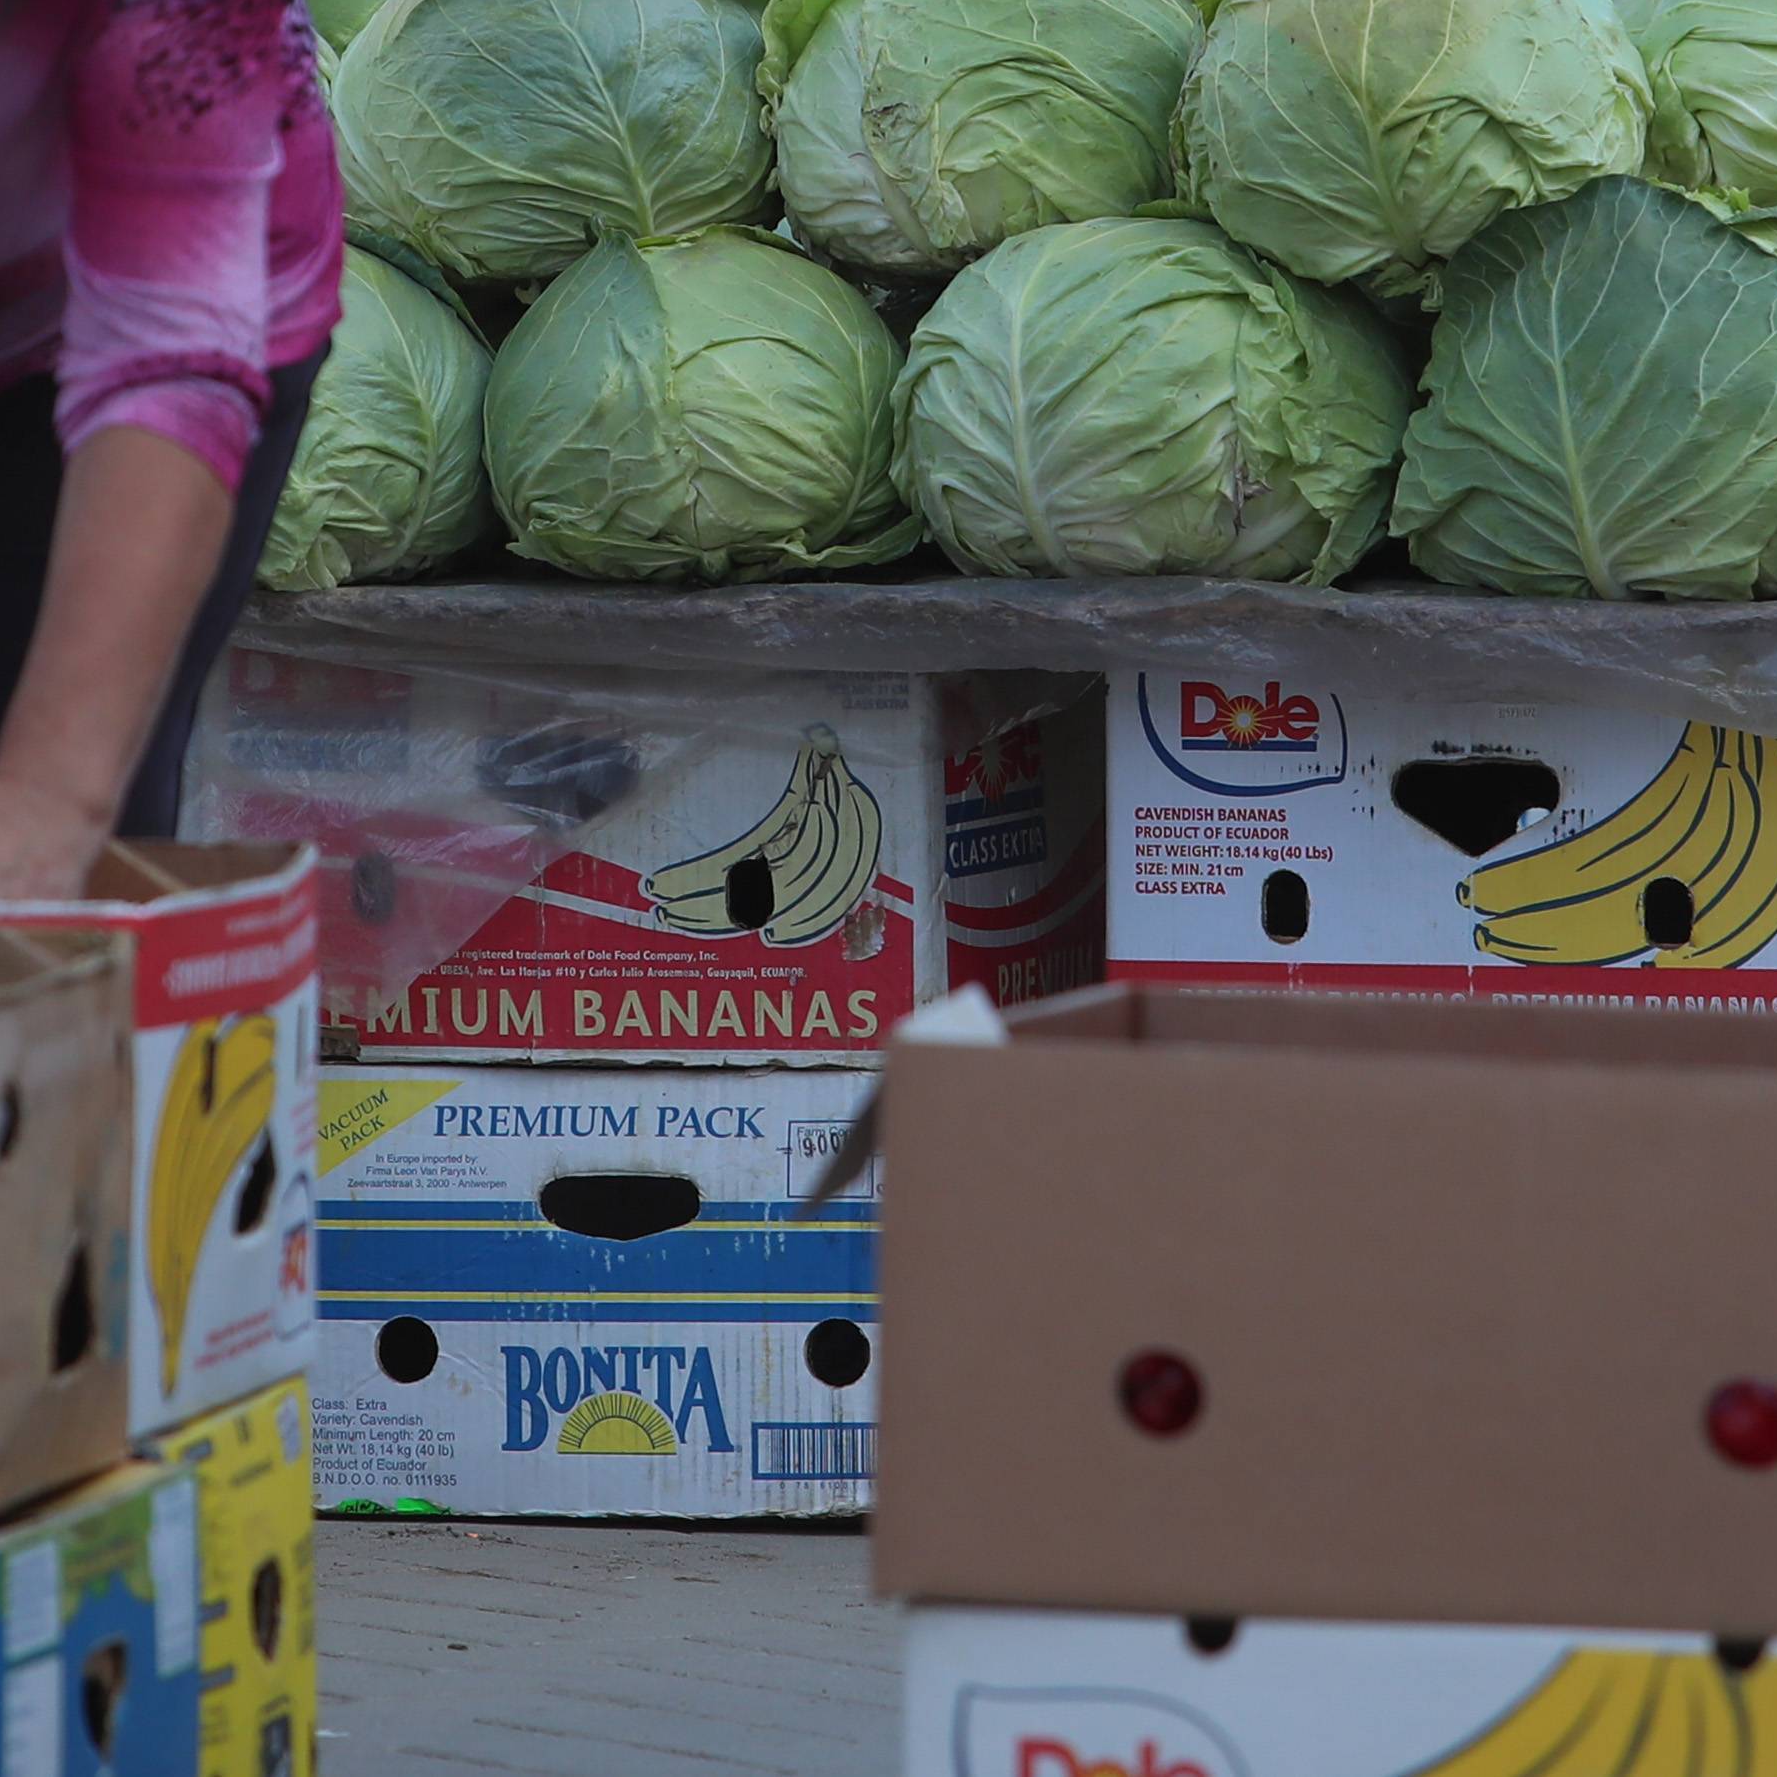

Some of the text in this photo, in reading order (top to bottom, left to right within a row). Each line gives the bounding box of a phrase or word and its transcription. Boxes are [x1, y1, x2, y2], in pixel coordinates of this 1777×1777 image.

[1181, 681, 1320, 742] Dole
[1135, 807, 1287, 822] CAVENDISH BANANAS
[1135, 826, 1289, 840] PRODUCT OF ECUADOR
[949, 833, 998, 869] CLASS
[1135, 844, 1162, 857] NET
[1305, 846, 1333, 862] Lbs)
[1135, 863, 1168, 875] SIZE:
[1171, 863, 1203, 875] MIN.
[1136, 881, 1226, 894] CLASS EXTRA
[462, 950, 513, 961] registered
[516, 950, 571, 960] trademark
[573, 950, 586, 960] of
[587, 950, 612, 960] Dole
[614, 950, 640, 960] Food
[643, 950, 696, 963] Company,
[699, 950, 719, 961] Inc.
[500, 966, 516, 976] Las
[579, 969, 586, 979] y
[589, 967, 619, 977] Carlos
[621, 967, 644, 977] Julio
[707, 967, 758, 980] Guayaquil,
[327, 986, 879, 1039] EMIUM BANANAS
[318, 1088, 389, 1141] VACUUM
[433, 1105, 765, 1139] PREMIUM PACK
[340, 1116, 386, 1151] PACK
[375, 1154, 478, 1165] In Europe imported by:
[366, 1166, 489, 1179] Firma Leon Van Parys N.V.
[347, 1178, 413, 1189] Zeevaartstraat
[426, 1179, 450, 1188] 2000
[458, 1178, 507, 1190] Antwerpen
[312, 1398, 387, 1410] Class: Extra
[500, 1345, 735, 1453] BONITA
[312, 1413, 422, 1427] Variety: Cavendish
[312, 1429, 455, 1443] Minimum Length: 20 cm
[312, 1443, 454, 1458] Net Wt. 18,14 kg (40 lb)
[312, 1458, 427, 1471] Product of Ecuador
[312, 1473, 457, 1486] B.N.D.O.O. no. 0111935
